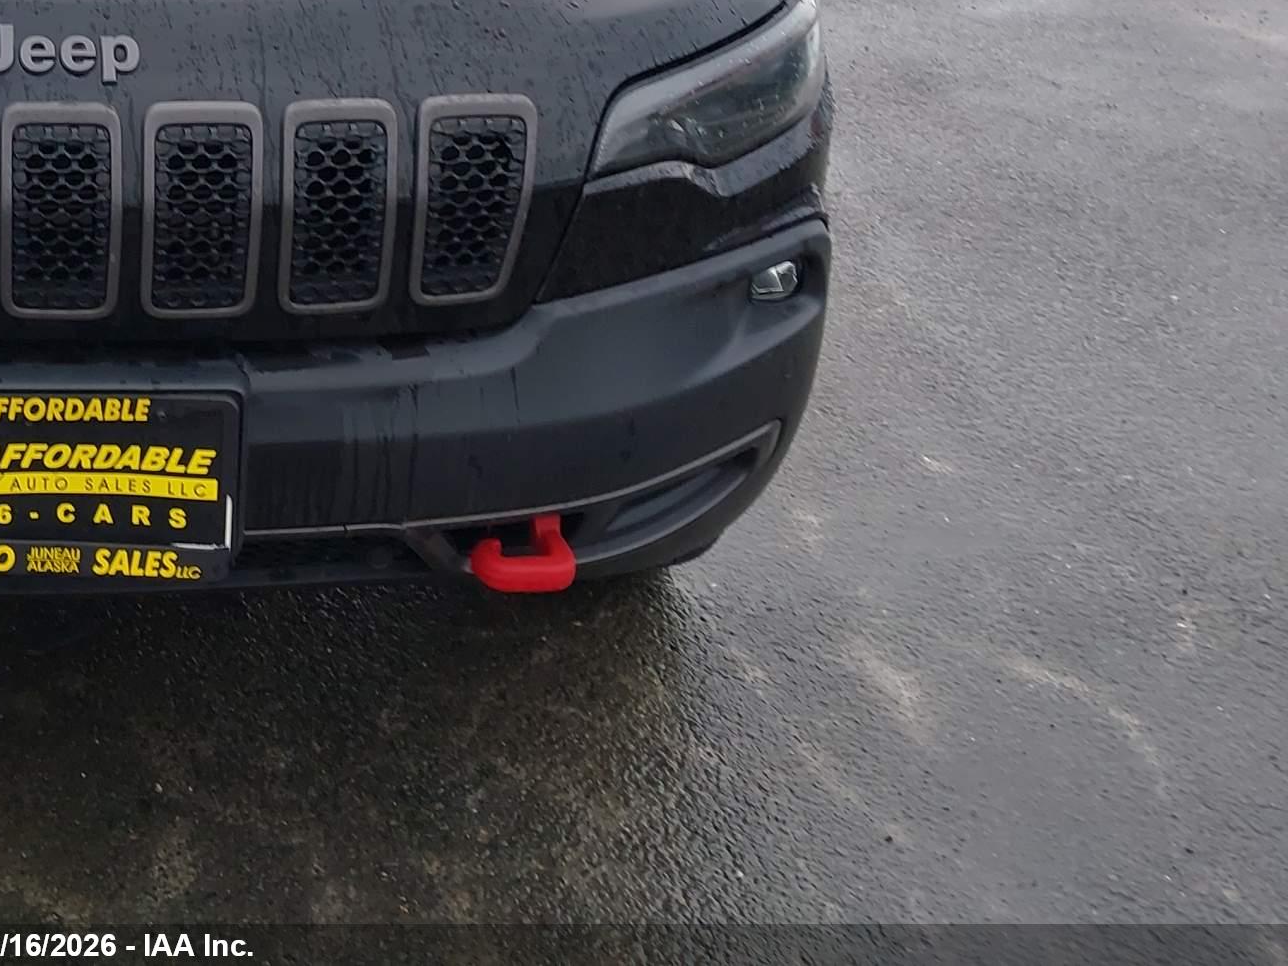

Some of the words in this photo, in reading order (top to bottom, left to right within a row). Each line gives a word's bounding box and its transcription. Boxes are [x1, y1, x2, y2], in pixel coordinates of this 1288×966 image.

[11, 476, 67, 491] AUTO
[84, 478, 151, 494] SALES
[167, 481, 208, 497] LLC
[27, 547, 80, 560] JUNEAU
[27, 561, 79, 573] ALASKA
[92, 547, 178, 578] SALES
[175, 566, 202, 579] LLC
